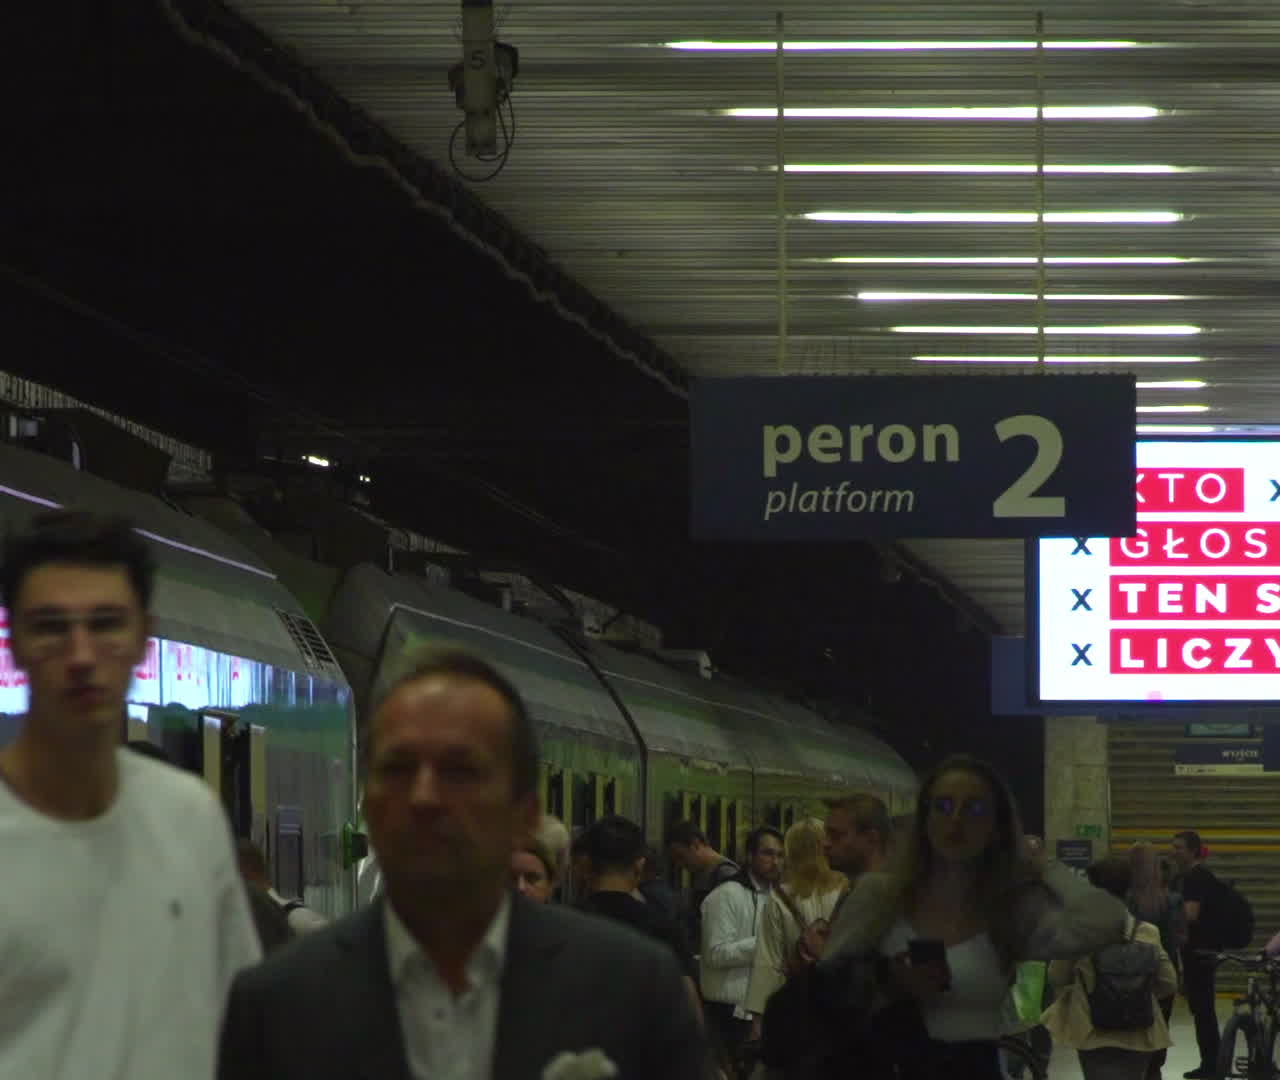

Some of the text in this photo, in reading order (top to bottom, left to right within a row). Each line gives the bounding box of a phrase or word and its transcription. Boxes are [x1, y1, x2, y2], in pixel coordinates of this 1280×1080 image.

[764, 414, 1066, 518] peron 2
[764, 481, 915, 521] platform
[1118, 583, 1228, 614] TEN
